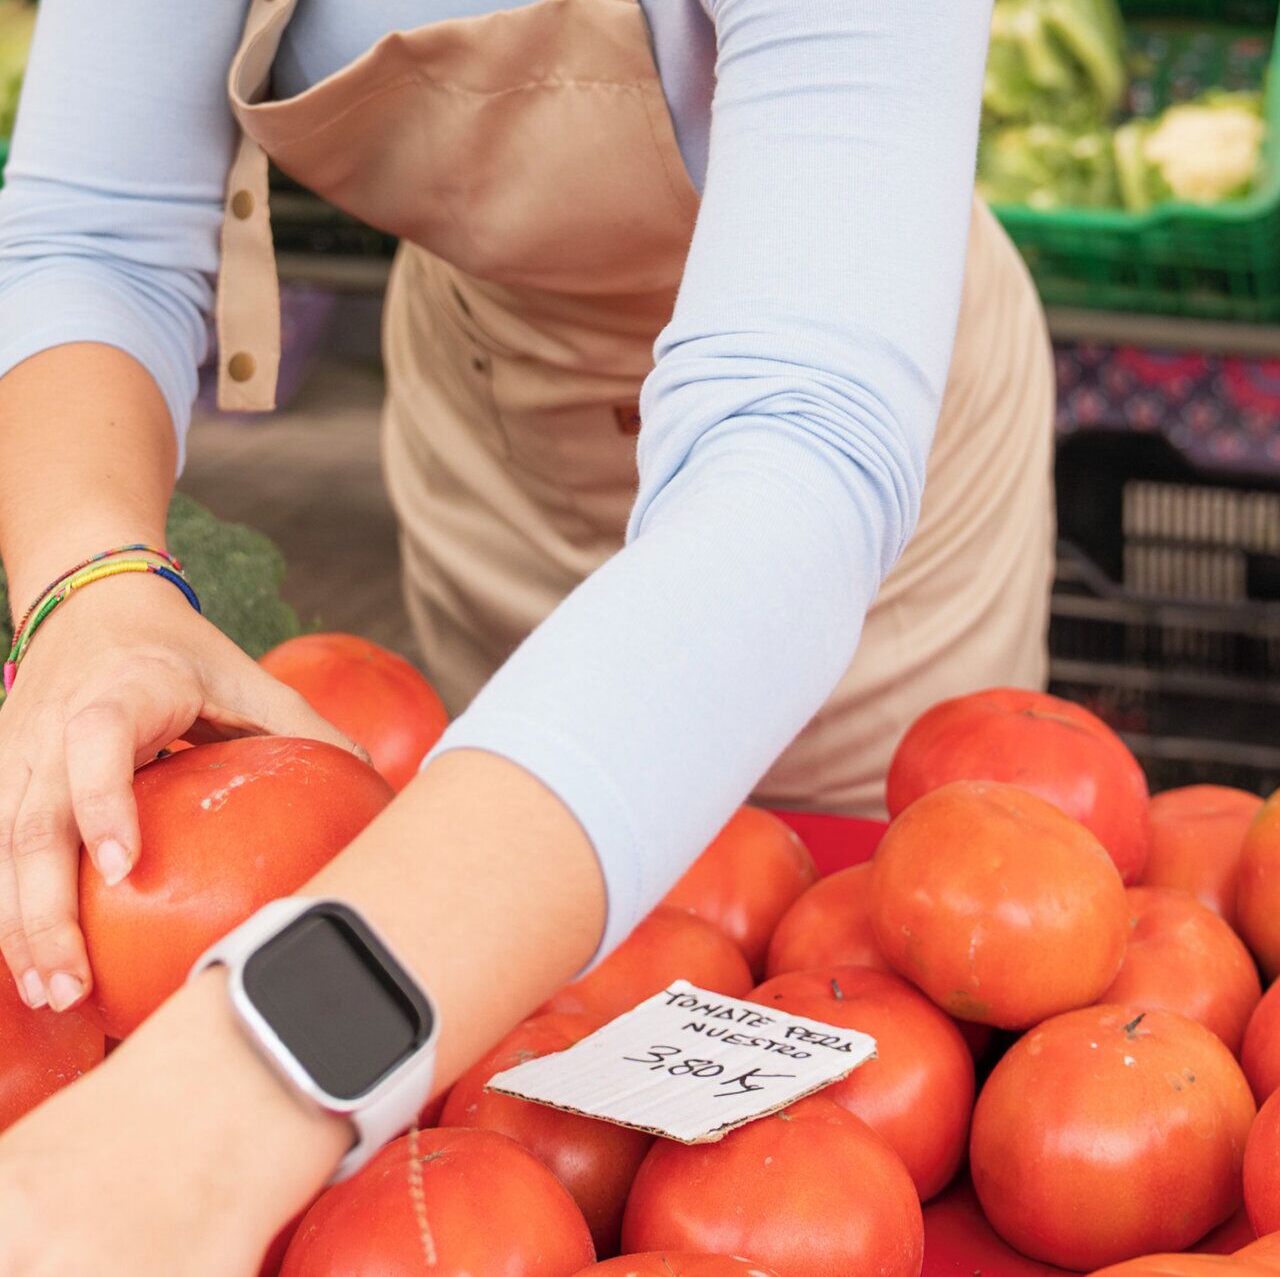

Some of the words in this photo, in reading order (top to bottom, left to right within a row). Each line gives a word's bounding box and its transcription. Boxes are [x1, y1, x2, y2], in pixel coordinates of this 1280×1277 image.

[663, 990, 773, 1028] TOMATE
[785, 1026, 853, 1053] PERA
[682, 1022, 813, 1059] NUESTRO
[624, 1045, 724, 1078] 3,80
